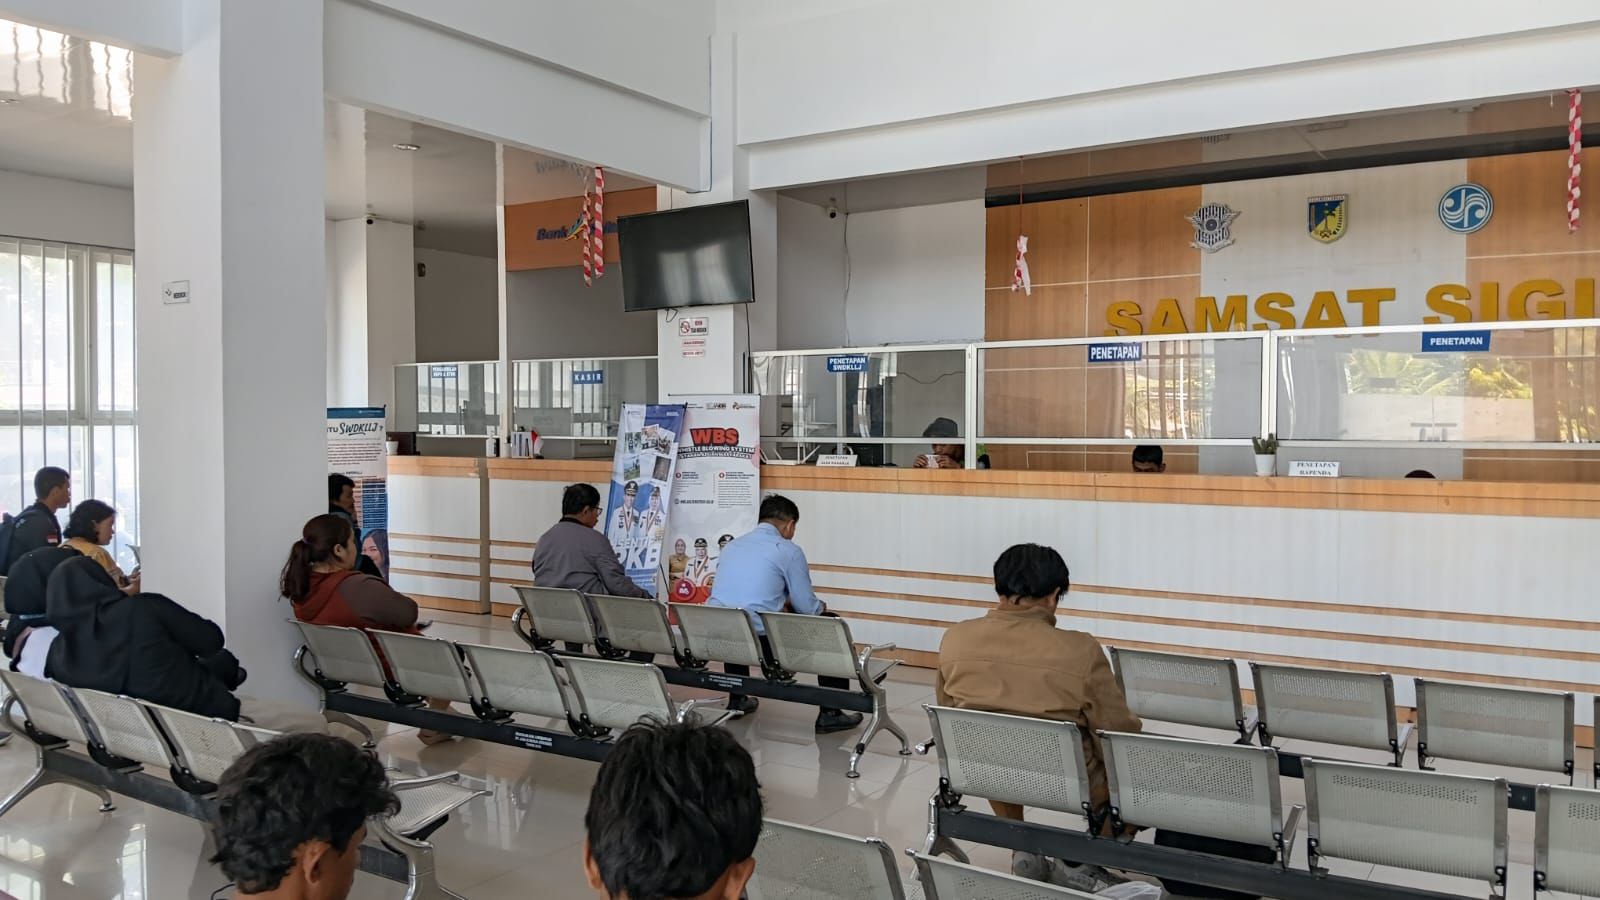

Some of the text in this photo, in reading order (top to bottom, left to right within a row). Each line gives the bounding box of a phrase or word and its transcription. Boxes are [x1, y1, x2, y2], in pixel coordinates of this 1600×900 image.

[1104, 278, 1594, 336] SAMSAT SIGI
[1429, 336, 1483, 346] PENETAPAN
[1090, 345, 1140, 360] PENETAPAN
[829, 357, 866, 365] PENETAPAN
[574, 373, 601, 381] KASIR
[339, 422, 378, 434] SWDKLLJ
[690, 427, 739, 446] WBS
